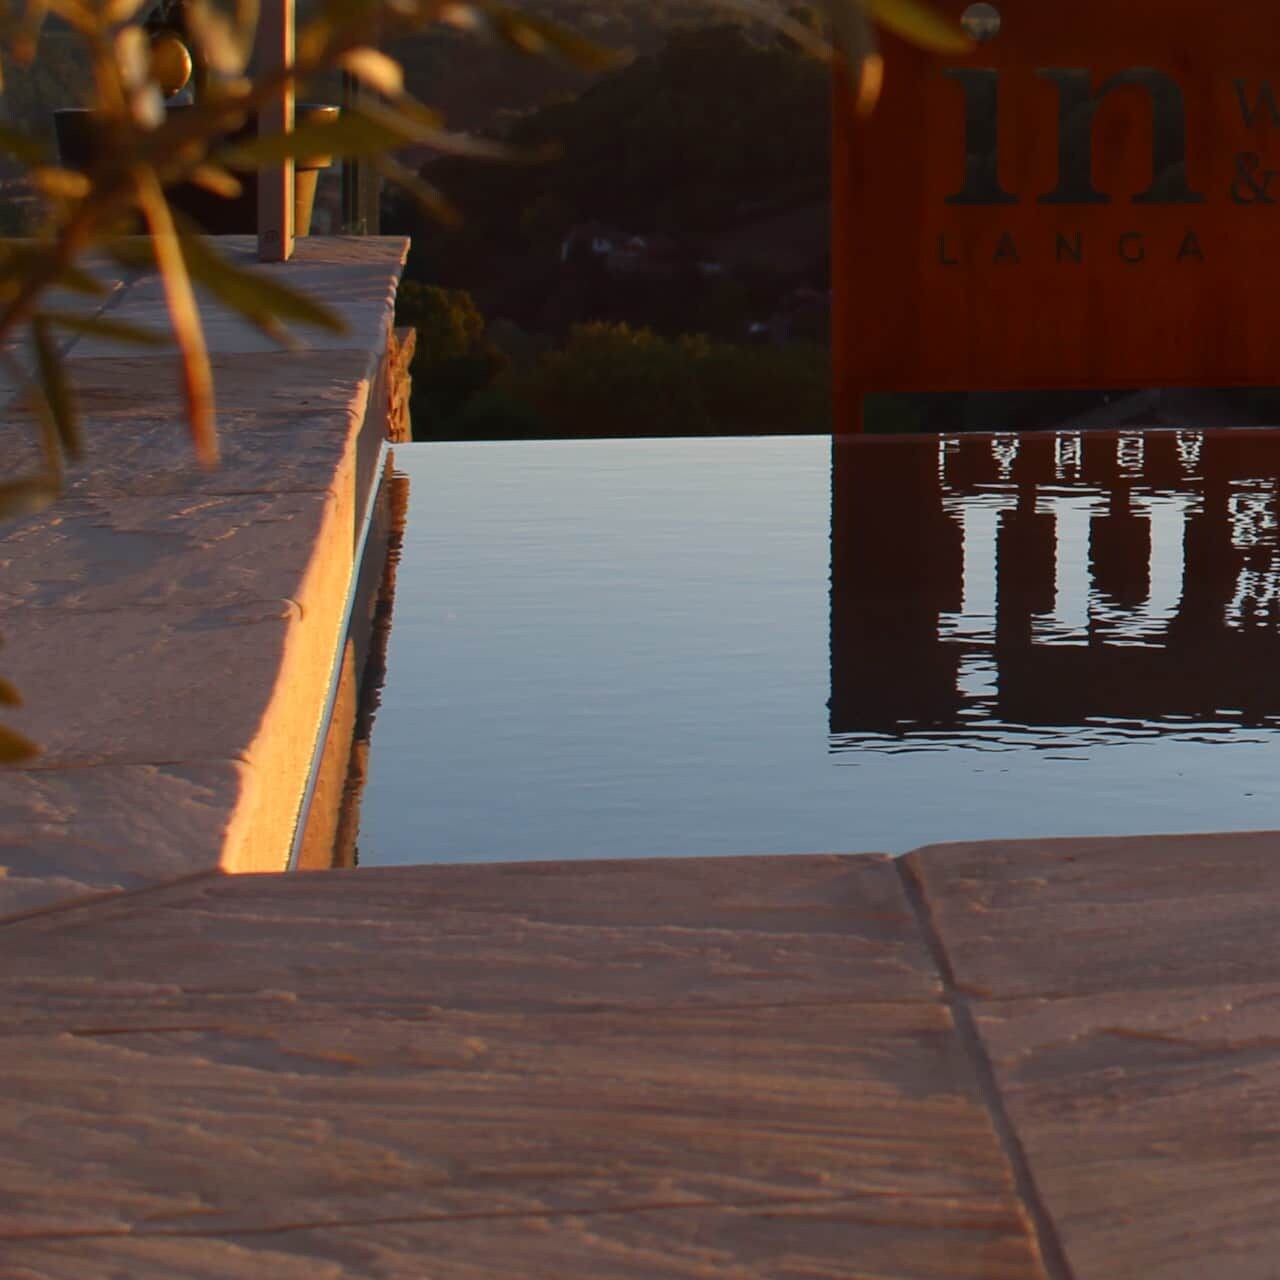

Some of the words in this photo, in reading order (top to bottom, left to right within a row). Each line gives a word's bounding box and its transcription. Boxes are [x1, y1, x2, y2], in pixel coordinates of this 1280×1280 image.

[943, 2, 1205, 205] in
[1231, 152, 1278, 205] &
[939, 231, 1205, 266] LANGA
